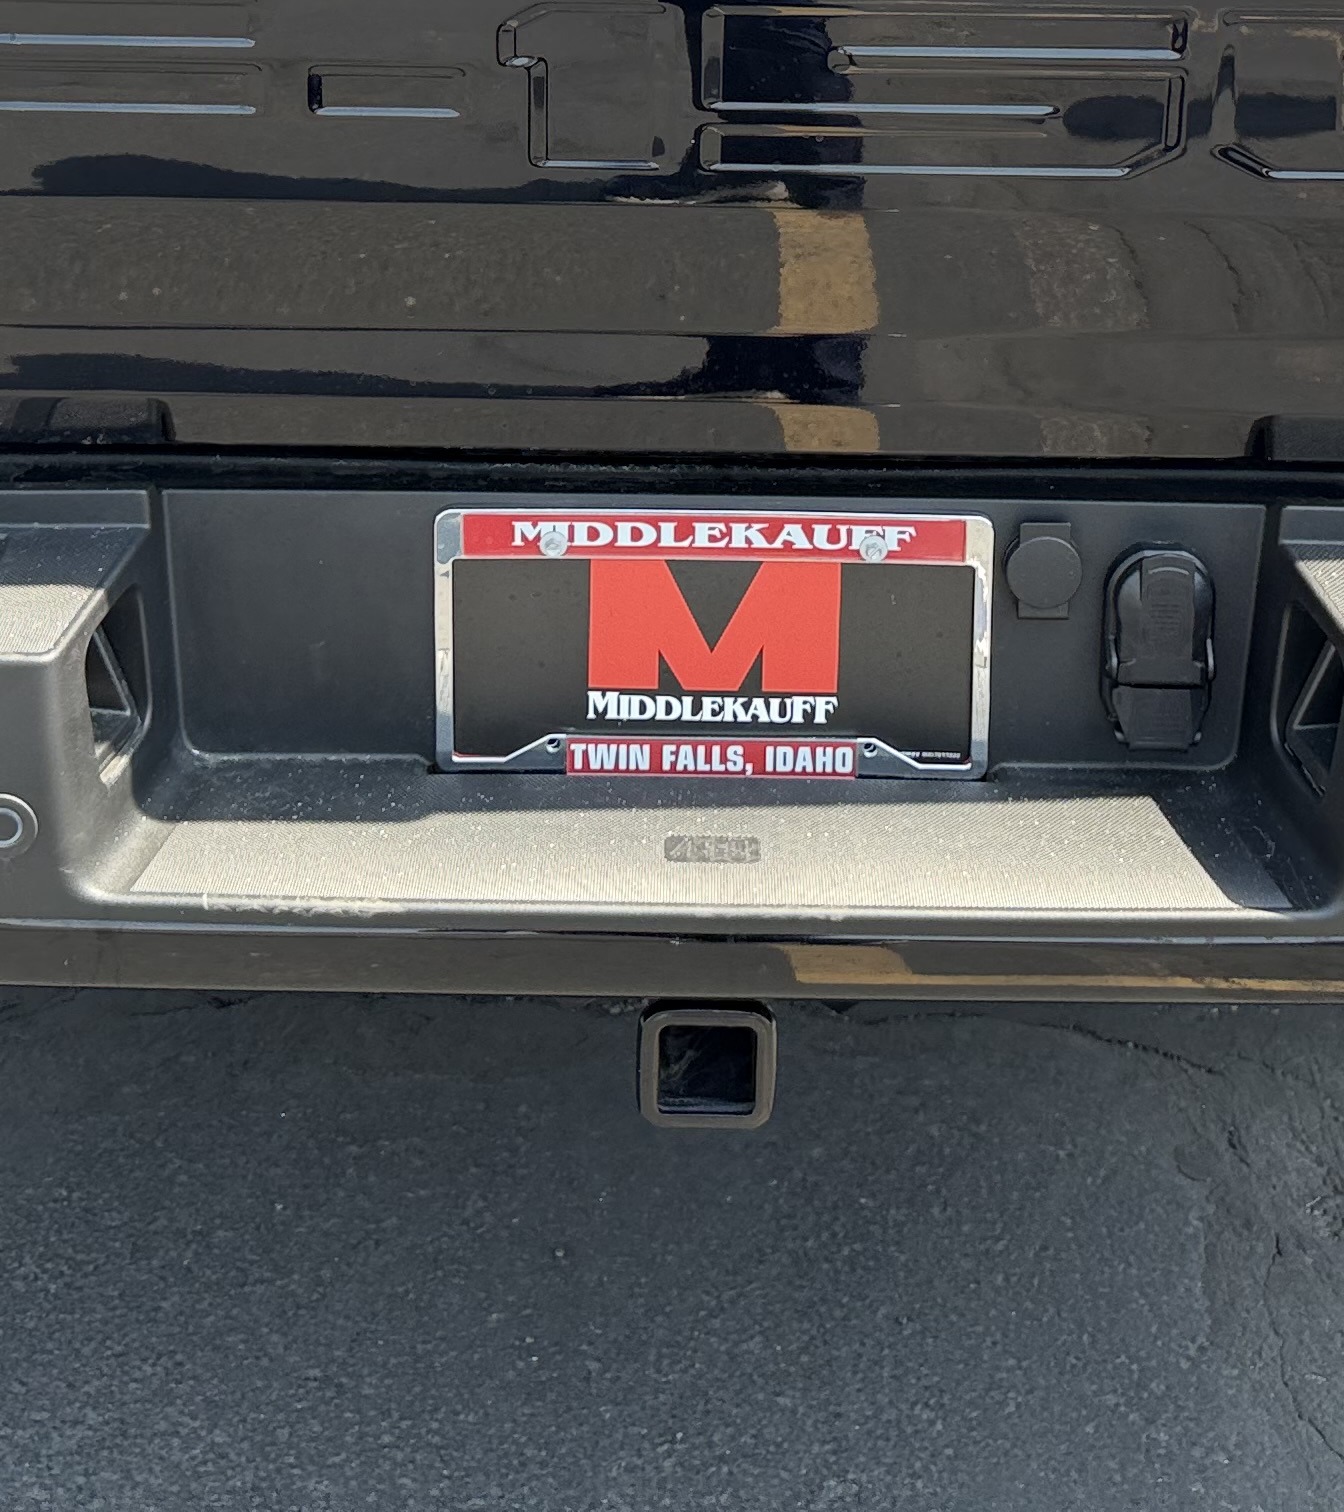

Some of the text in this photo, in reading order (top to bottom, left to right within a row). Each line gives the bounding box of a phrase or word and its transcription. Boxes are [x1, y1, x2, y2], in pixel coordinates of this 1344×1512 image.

[511, 520, 918, 551] MIDDLEKAUFF
[588, 558, 842, 693] M
[586, 690, 839, 725] MIDDLEKAUFF
[570, 742, 855, 776] TWIN FALLS, IDAHO
